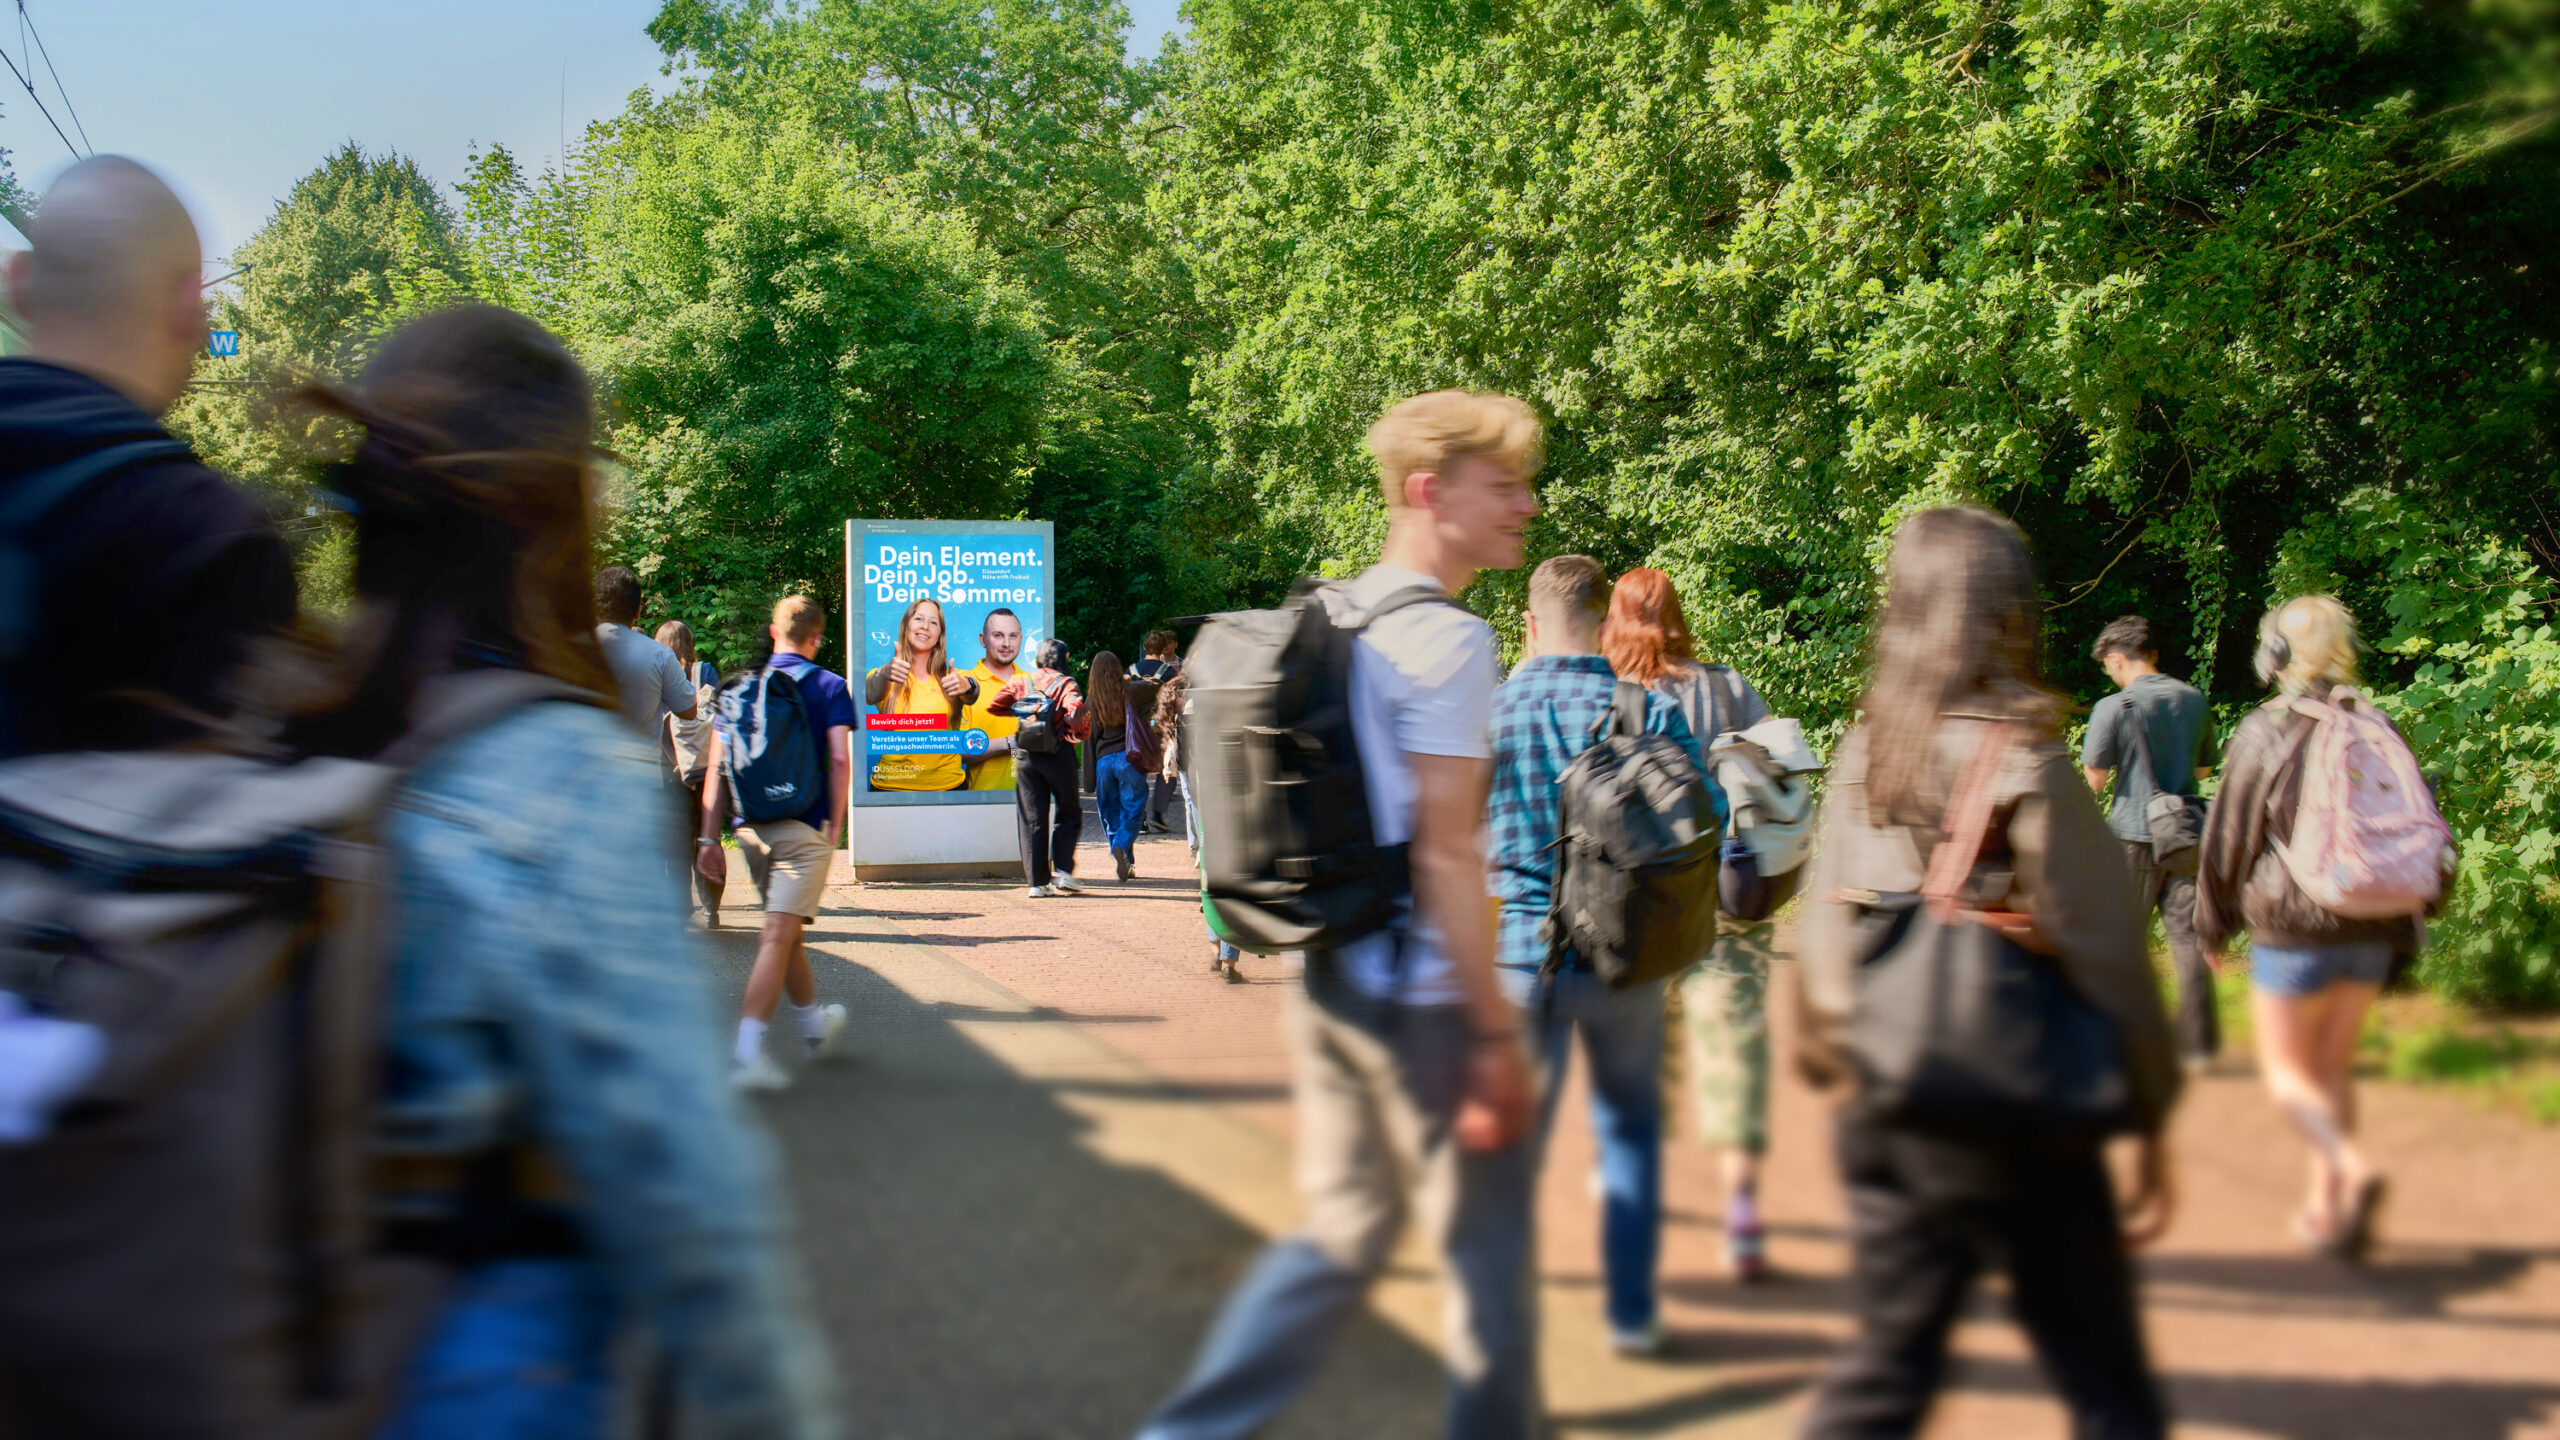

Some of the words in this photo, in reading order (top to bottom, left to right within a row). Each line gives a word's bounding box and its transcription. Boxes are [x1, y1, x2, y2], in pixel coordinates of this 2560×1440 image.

[212, 334, 235, 353] W
[880, 545, 933, 566] Dein
[940, 545, 1043, 567] Element.
[864, 564, 917, 584] Dein
[923, 564, 975, 584] Job.
[877, 582, 930, 603] Dein
[937, 583, 1041, 603] Sommer.
[915, 718, 935, 726] jetzt!
[871, 735, 906, 743] Verstärke
[871, 743, 957, 751] Rettungsschwimmer:in.
